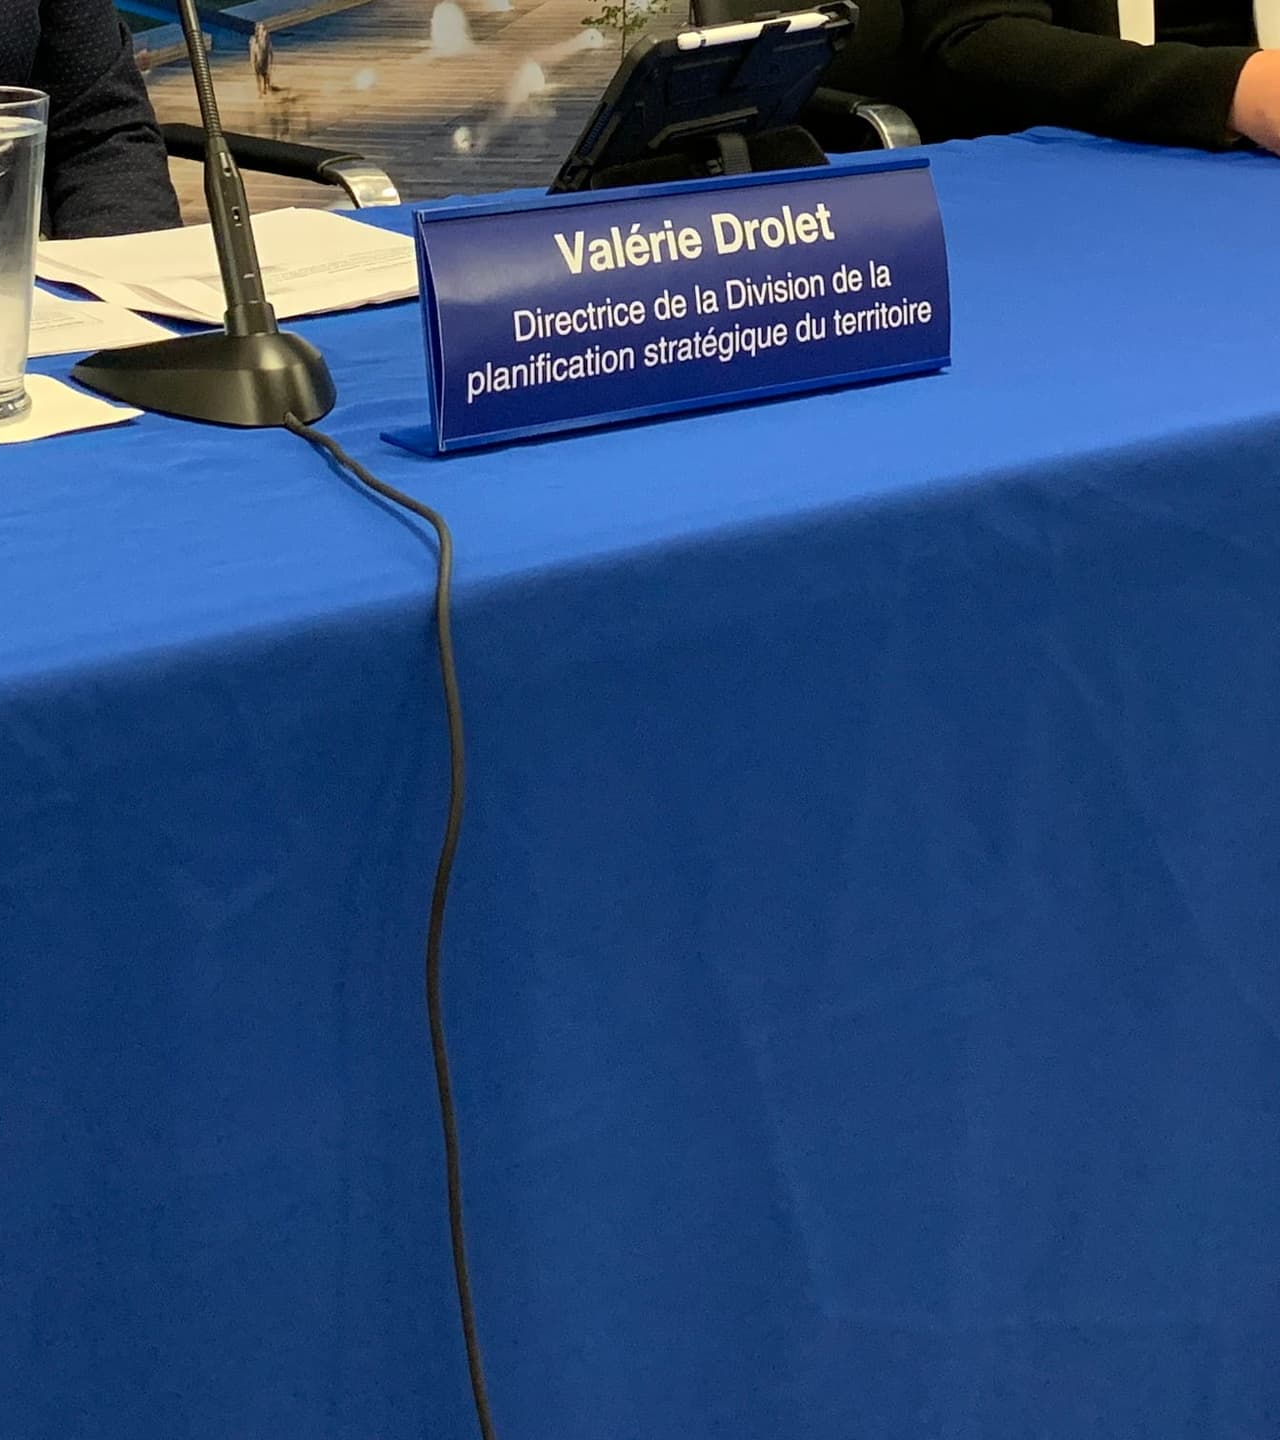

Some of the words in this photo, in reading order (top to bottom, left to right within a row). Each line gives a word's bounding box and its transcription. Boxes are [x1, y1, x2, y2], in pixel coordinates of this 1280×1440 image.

[553, 219, 703, 276] Valérie
[710, 202, 836, 255] Drolet
[512, 297, 646, 343] Directrice
[653, 289, 687, 321] de
[694, 284, 720, 315] la
[725, 274, 825, 310] Division
[831, 263, 863, 295] de
[869, 260, 892, 289] la
[466, 345, 636, 404] planification
[642, 323, 788, 368] stratégique
[795, 313, 826, 343] du
[832, 297, 932, 336] territoire
